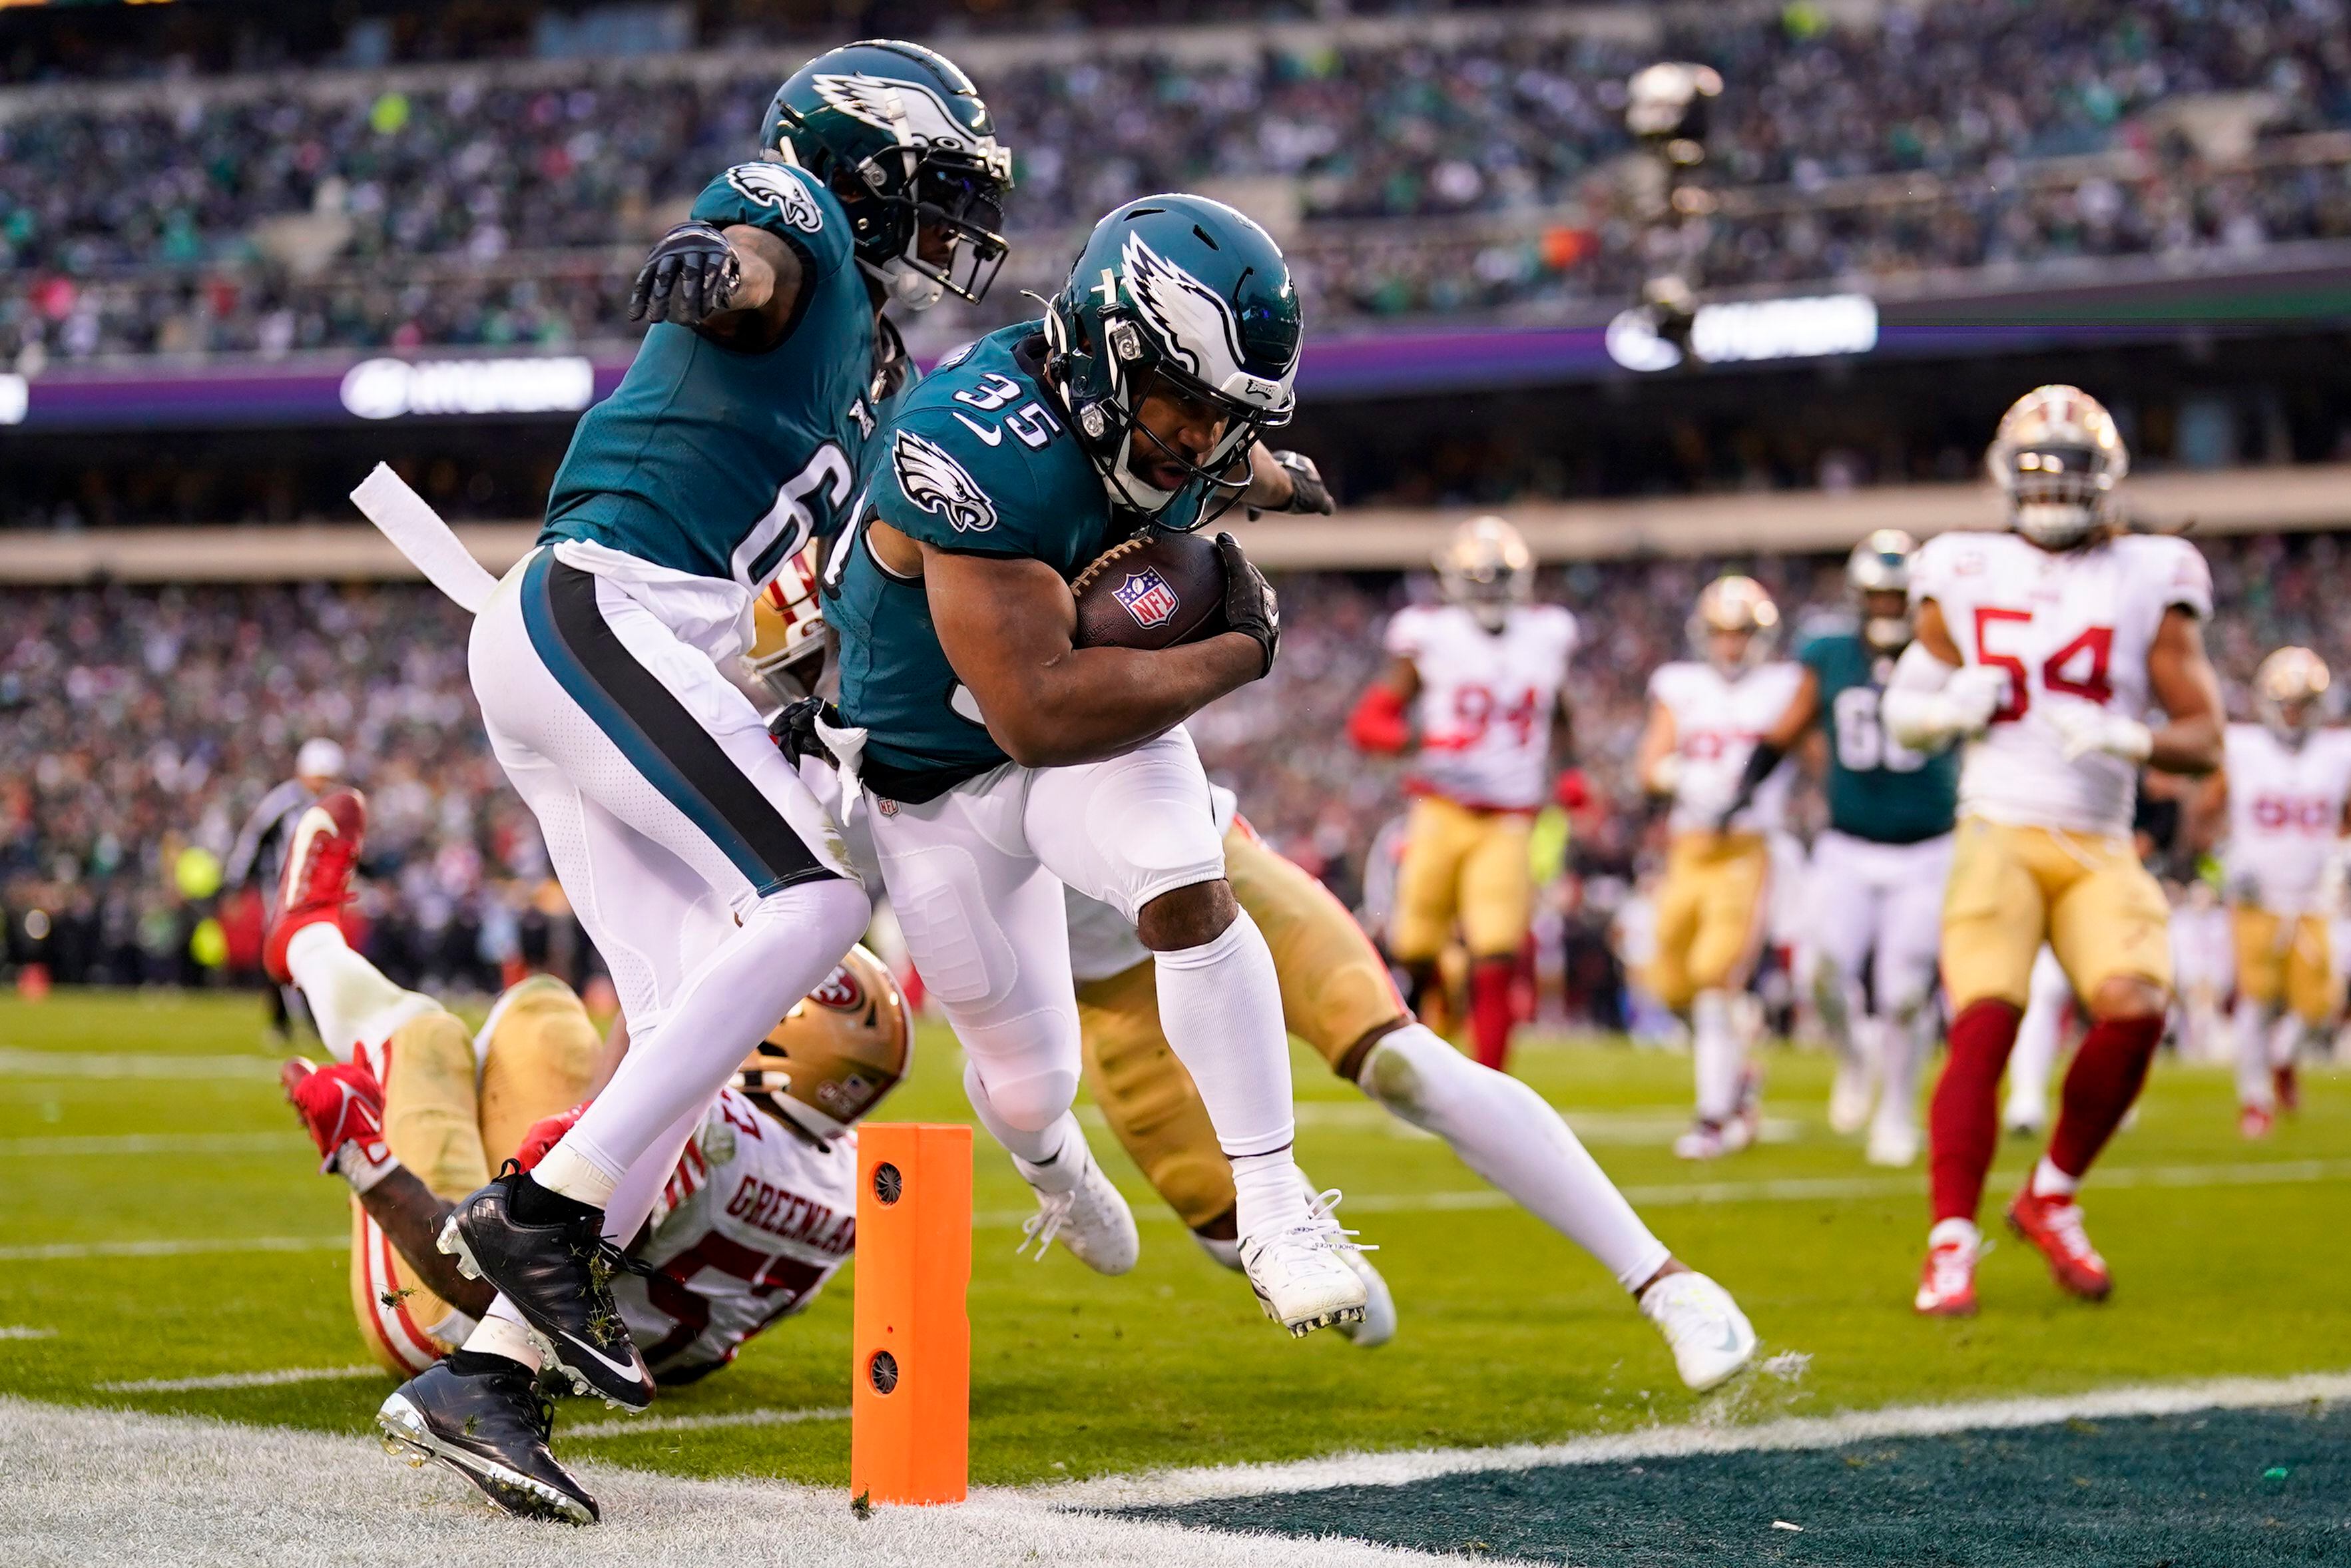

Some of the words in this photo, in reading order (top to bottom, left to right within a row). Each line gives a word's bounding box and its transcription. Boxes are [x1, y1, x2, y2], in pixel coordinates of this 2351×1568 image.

[952, 372, 1065, 452] 35
[730, 441, 854, 601] 6
[1132, 587, 1175, 624] NFL
[1974, 607, 2115, 724] 54
[1453, 683, 1537, 751] 94
[1834, 686, 1926, 773] 6
[880, 800, 898, 814] NFL
